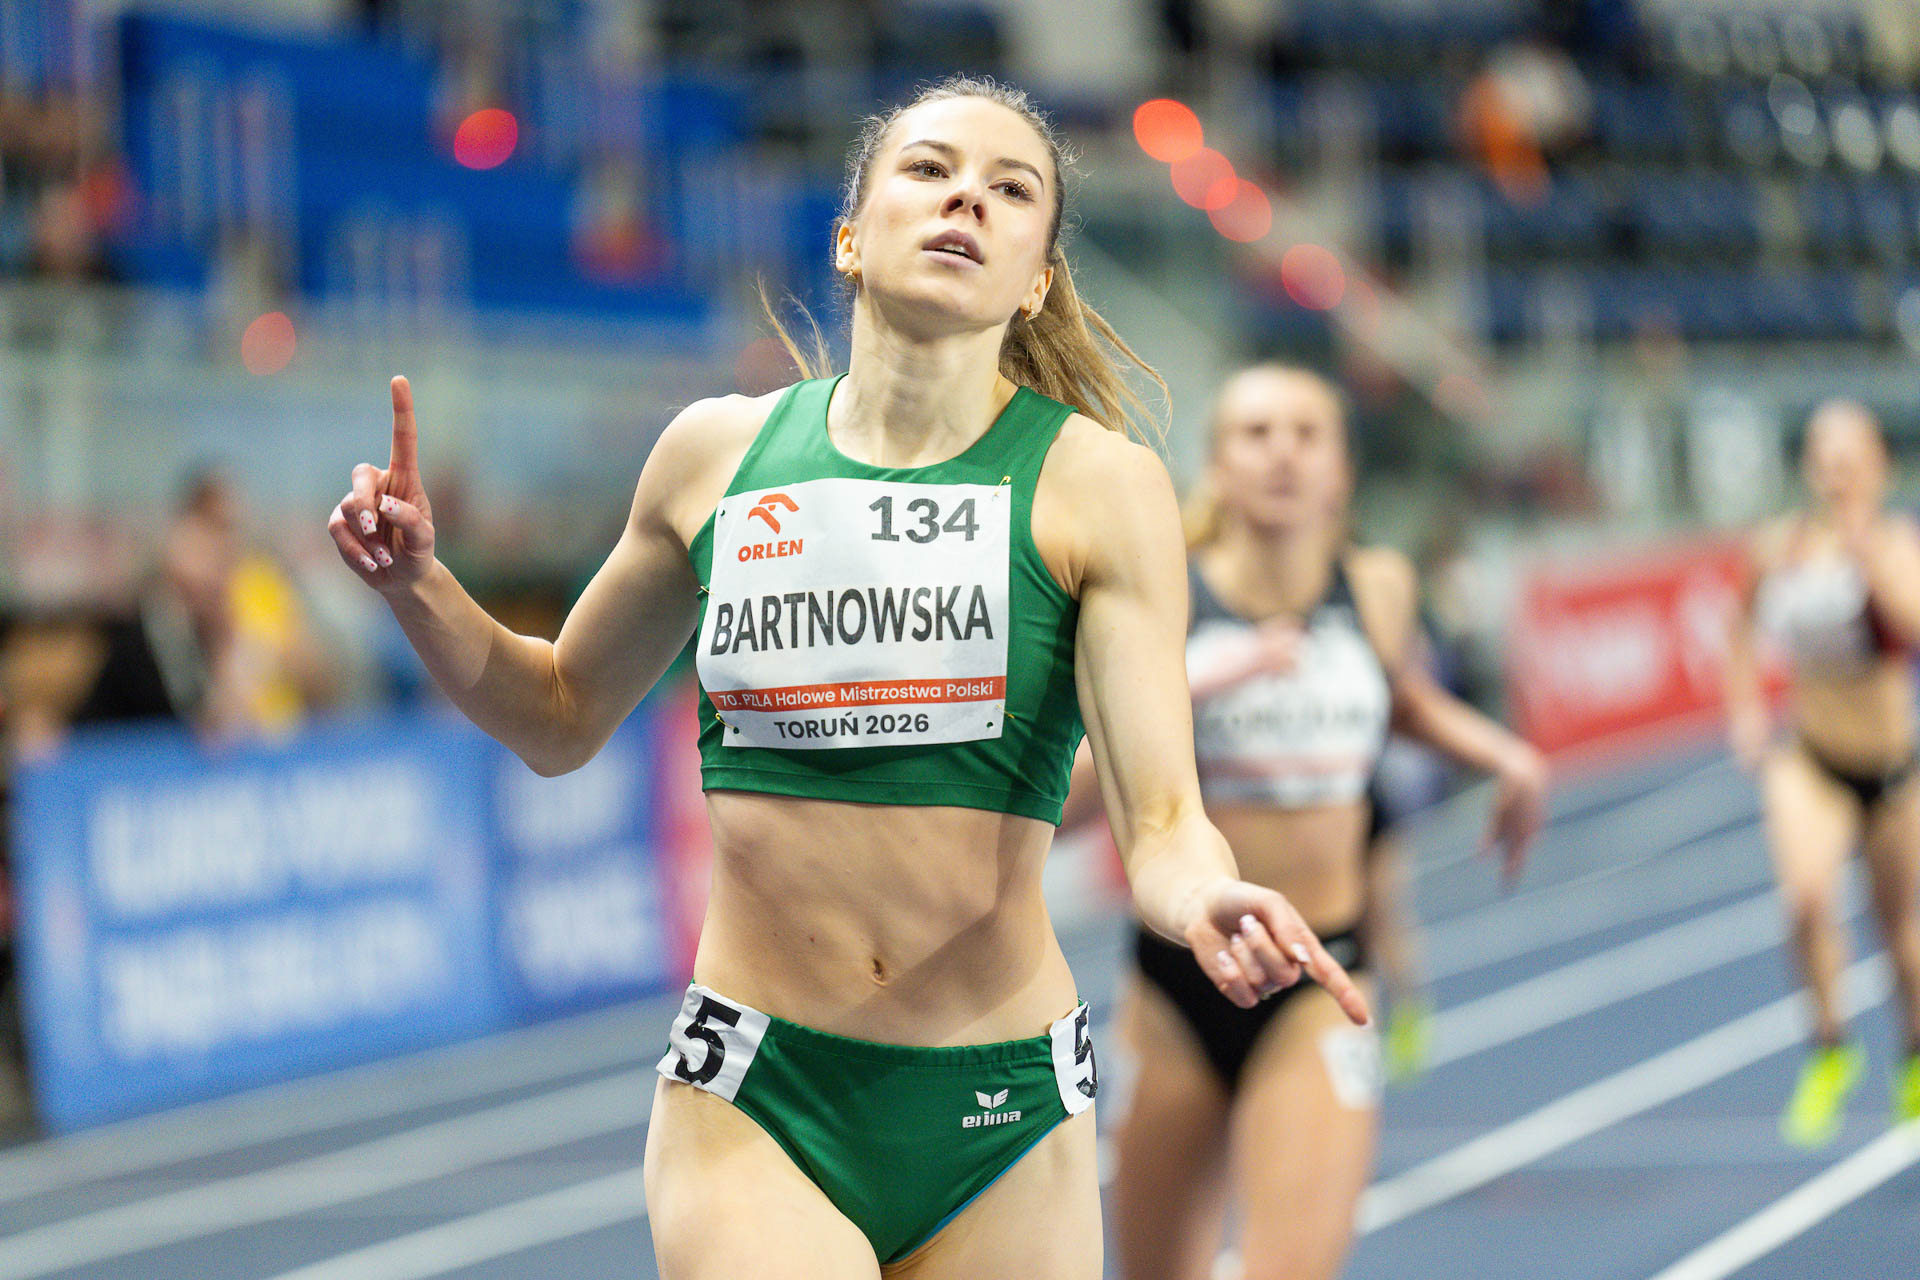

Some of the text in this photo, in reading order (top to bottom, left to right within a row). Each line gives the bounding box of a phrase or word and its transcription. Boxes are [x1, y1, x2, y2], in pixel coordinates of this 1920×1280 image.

[869, 496, 980, 544] 134
[737, 538, 804, 563] ORLEN
[710, 585, 994, 656] BARTNOWSKA
[718, 680, 994, 708] 70. PZLA Halowe Mistrzostwa Polski
[774, 711, 930, 740] TORUŃ 2026
[673, 994, 742, 1087] 5
[1074, 1004, 1098, 1099] 5
[961, 1110, 1022, 1129] erima
